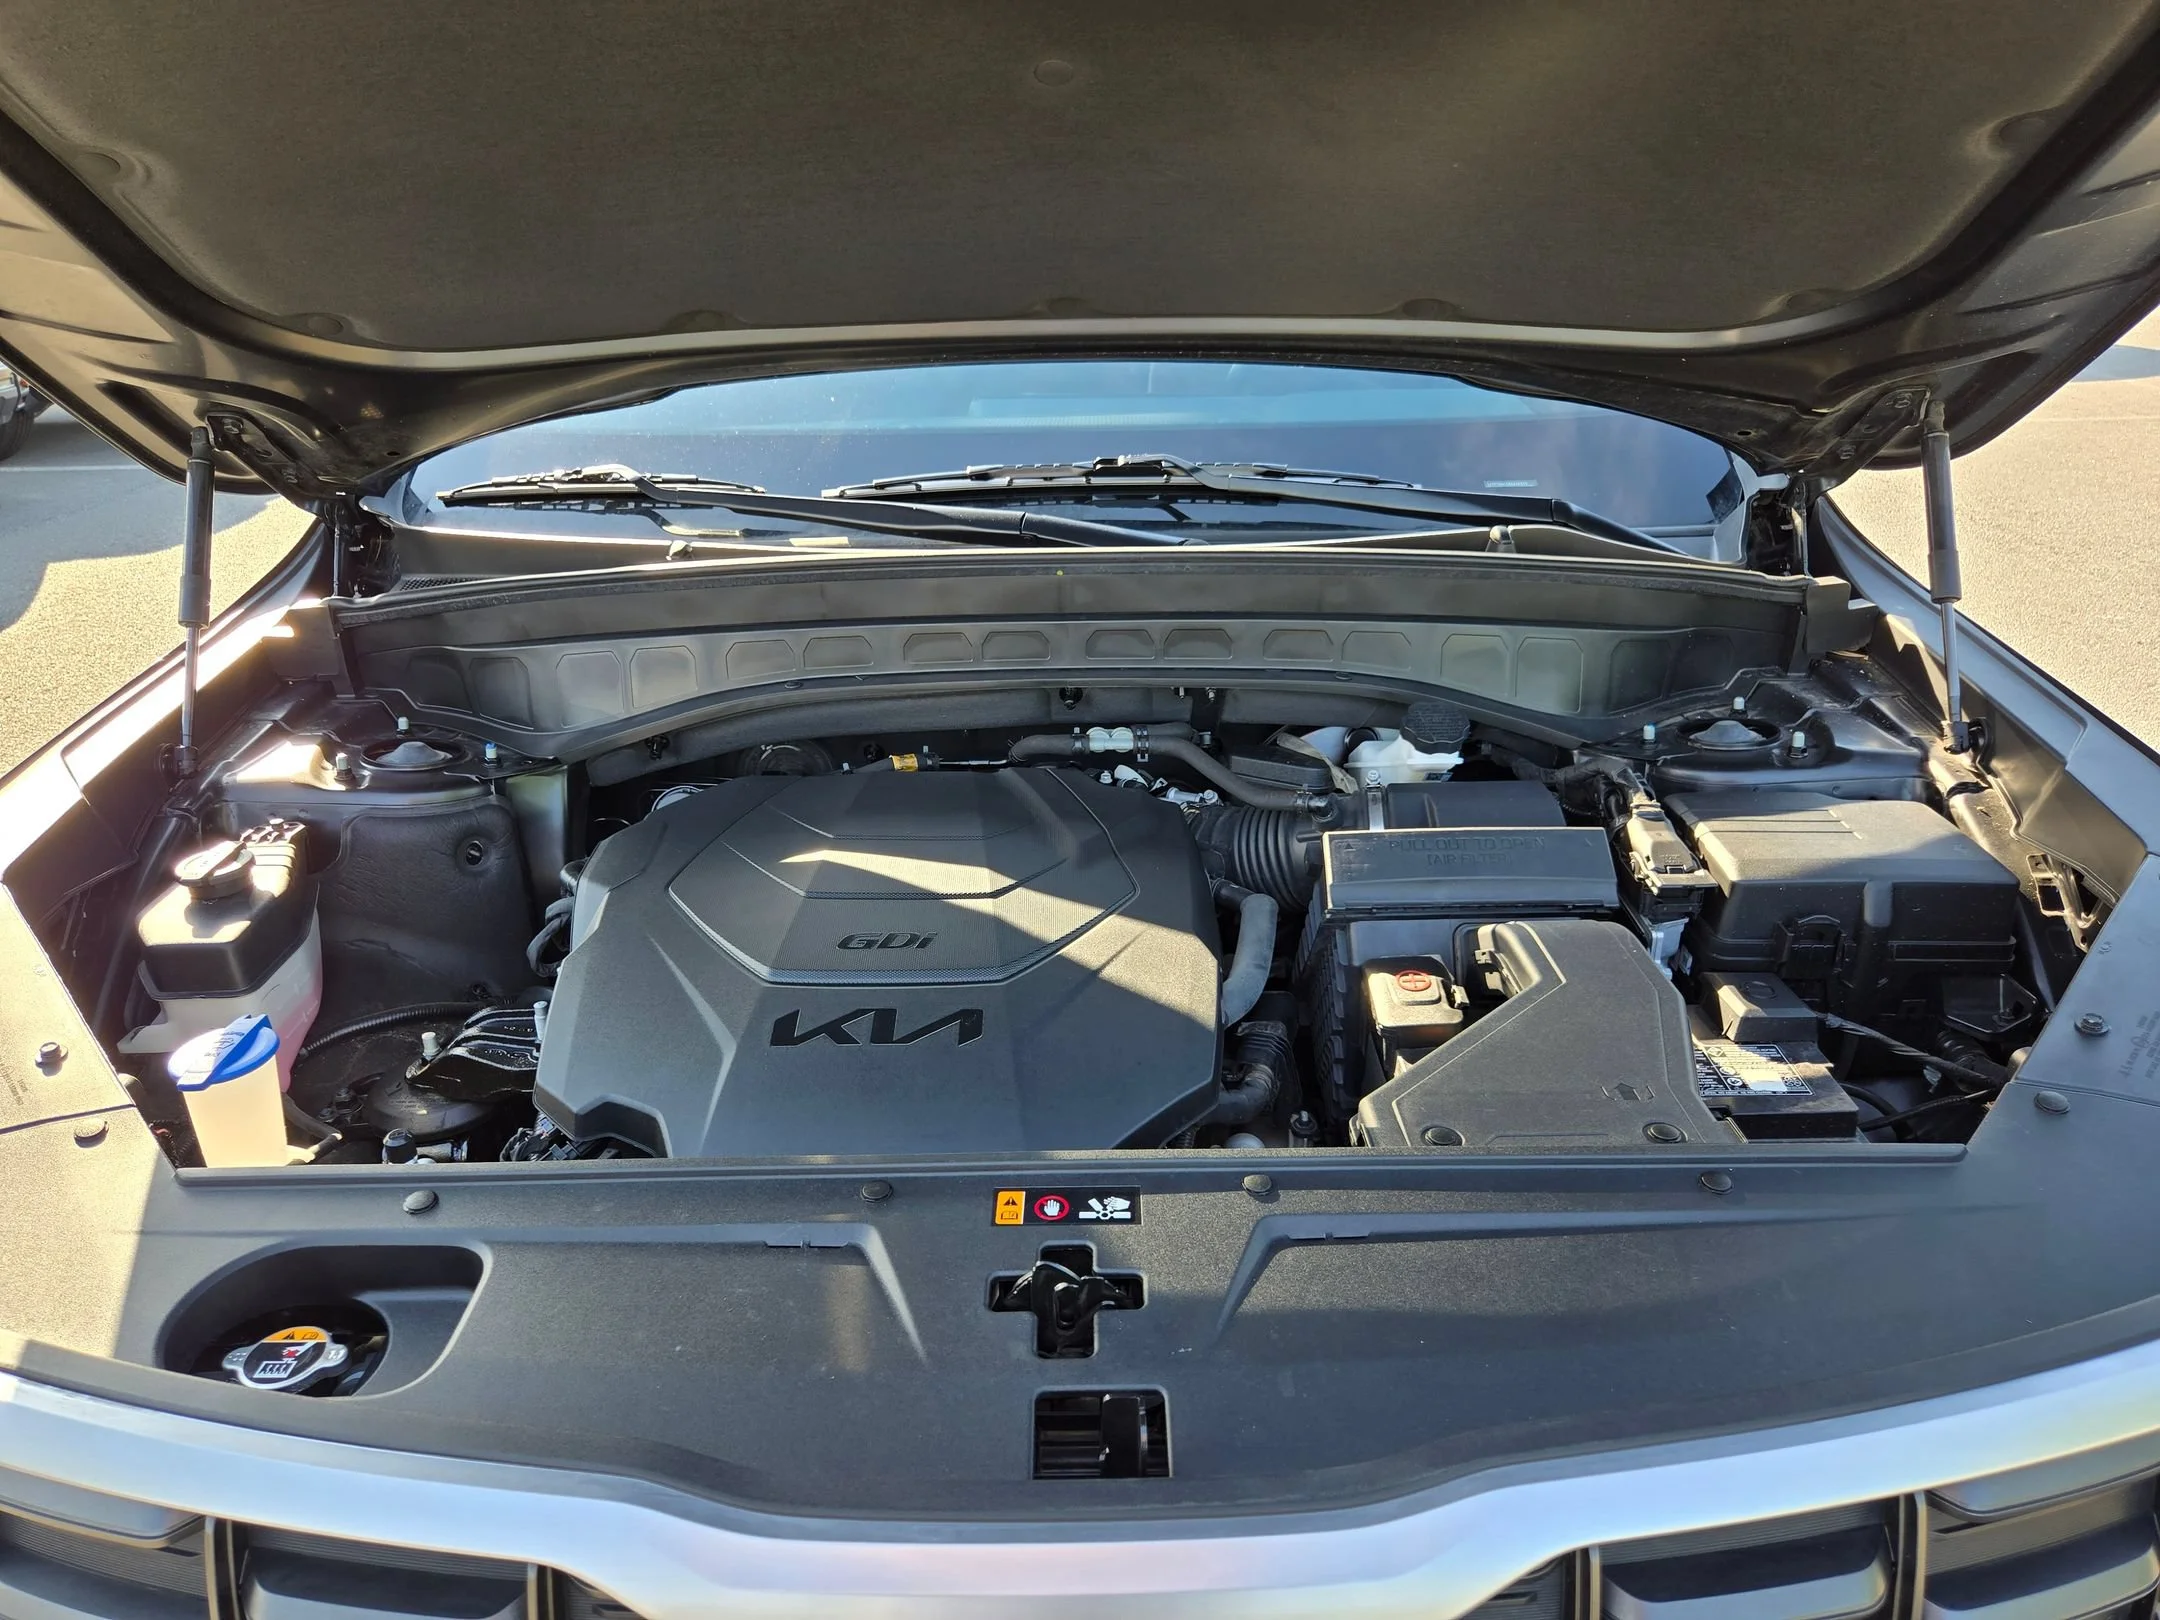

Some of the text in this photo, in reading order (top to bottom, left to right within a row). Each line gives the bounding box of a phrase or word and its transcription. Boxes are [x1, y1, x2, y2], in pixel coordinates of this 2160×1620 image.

[1389, 836, 1545, 851] PULL OUT TO OPEN
[836, 932, 938, 950] GDi
[770, 1008, 984, 1047] KIA
